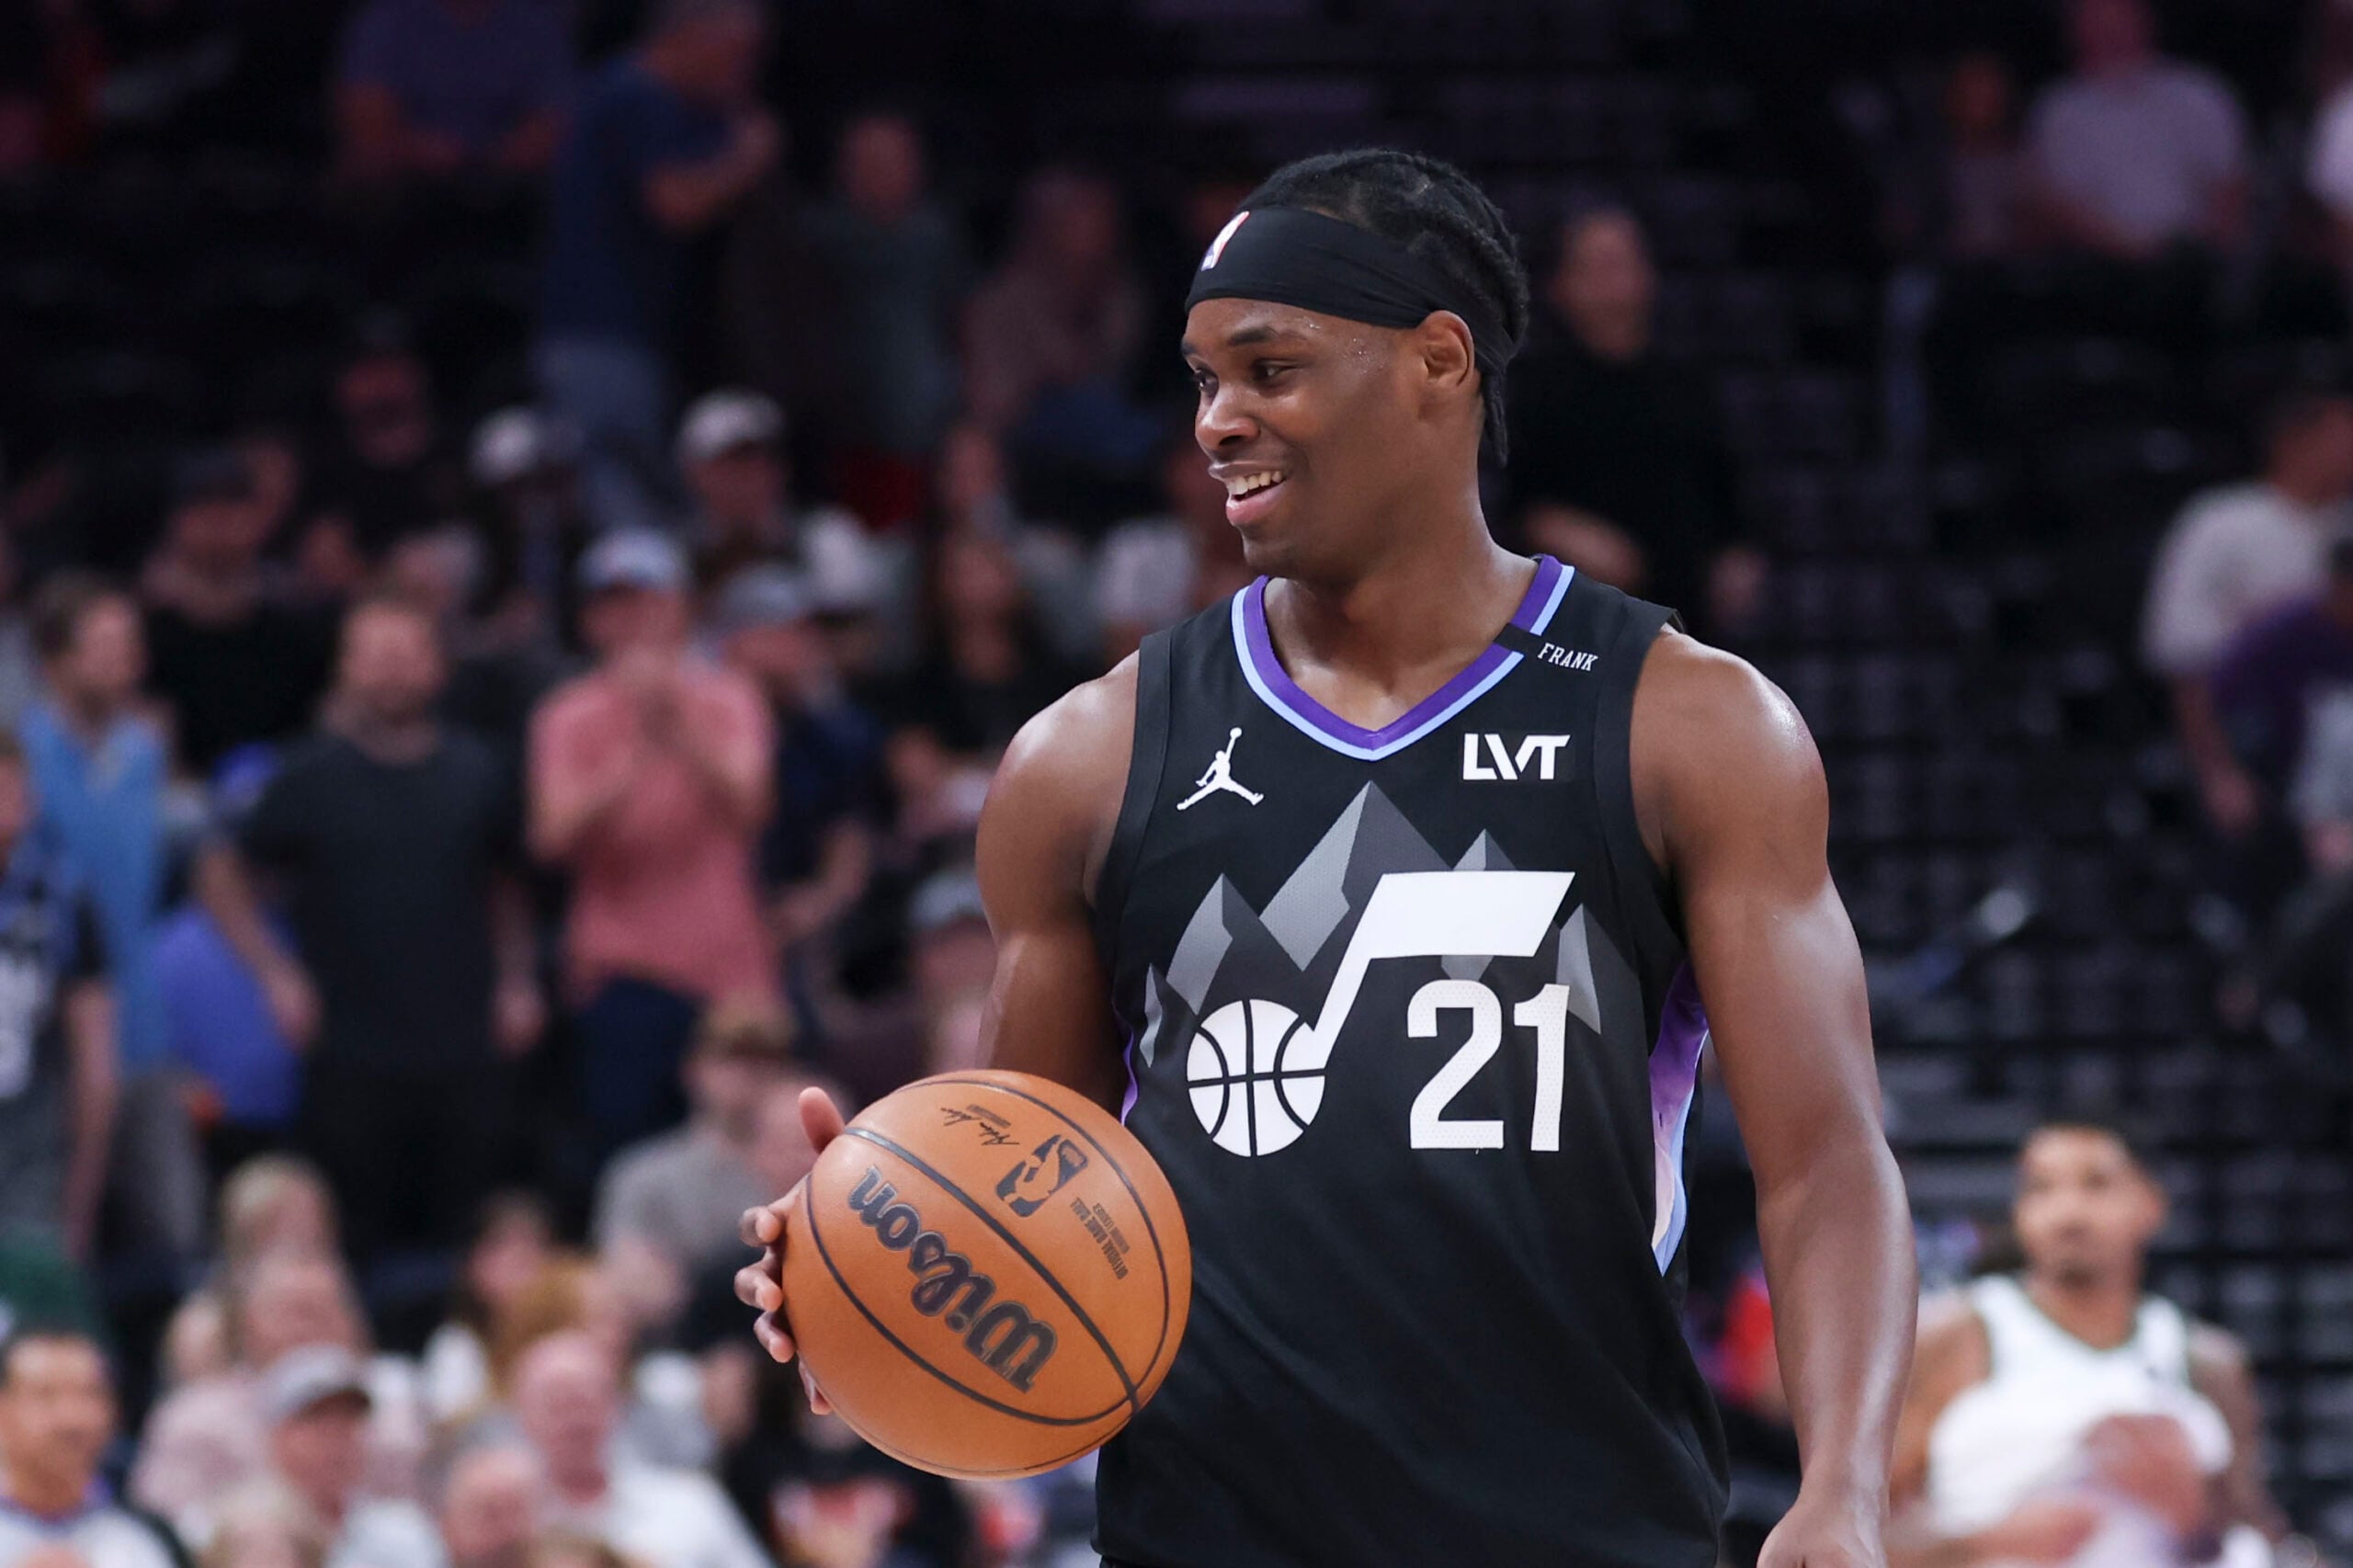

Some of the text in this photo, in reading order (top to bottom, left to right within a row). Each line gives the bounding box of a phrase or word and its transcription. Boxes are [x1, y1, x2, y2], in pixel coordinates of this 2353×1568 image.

[1538, 642, 1598, 671] FRANK
[1462, 733, 1571, 779] LVT
[1407, 979, 1570, 1152] 21
[848, 1165, 1058, 1394] Wilson
